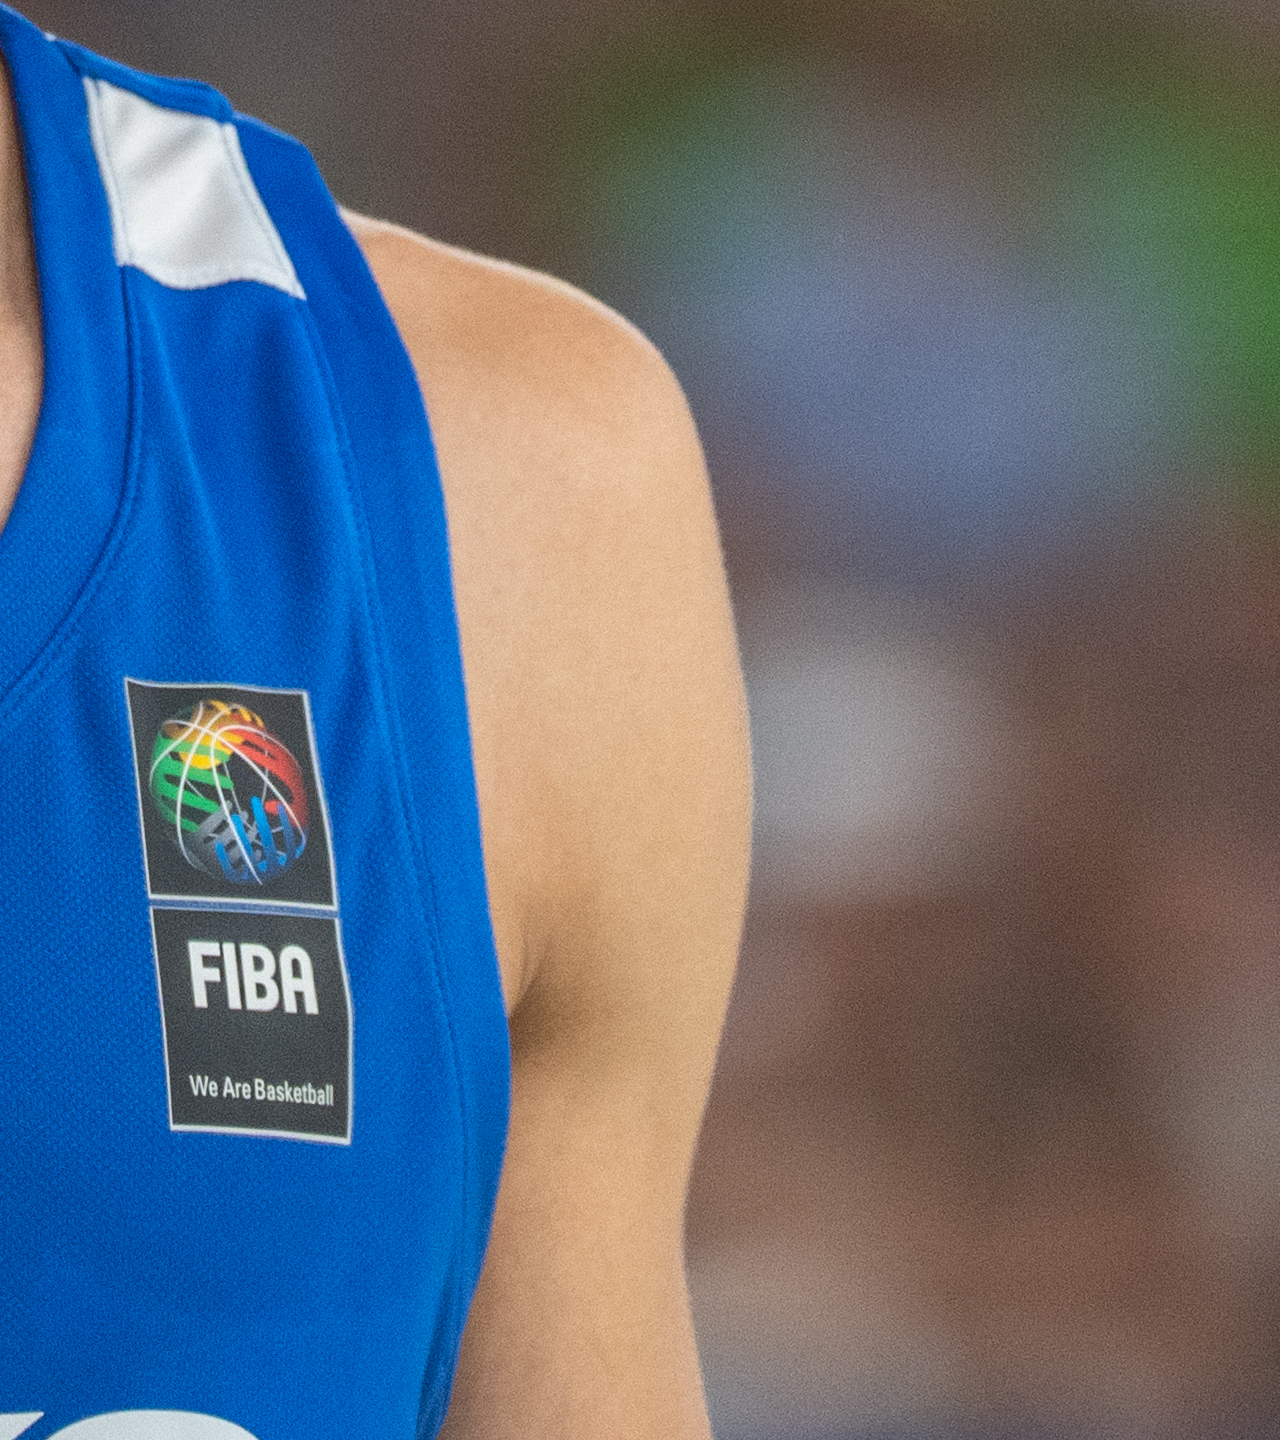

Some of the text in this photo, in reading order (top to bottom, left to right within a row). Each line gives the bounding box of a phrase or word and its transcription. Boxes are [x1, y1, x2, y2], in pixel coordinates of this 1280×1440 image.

[187, 939, 320, 1015] FIBA
[188, 1074, 335, 1107] We Are Basketball
